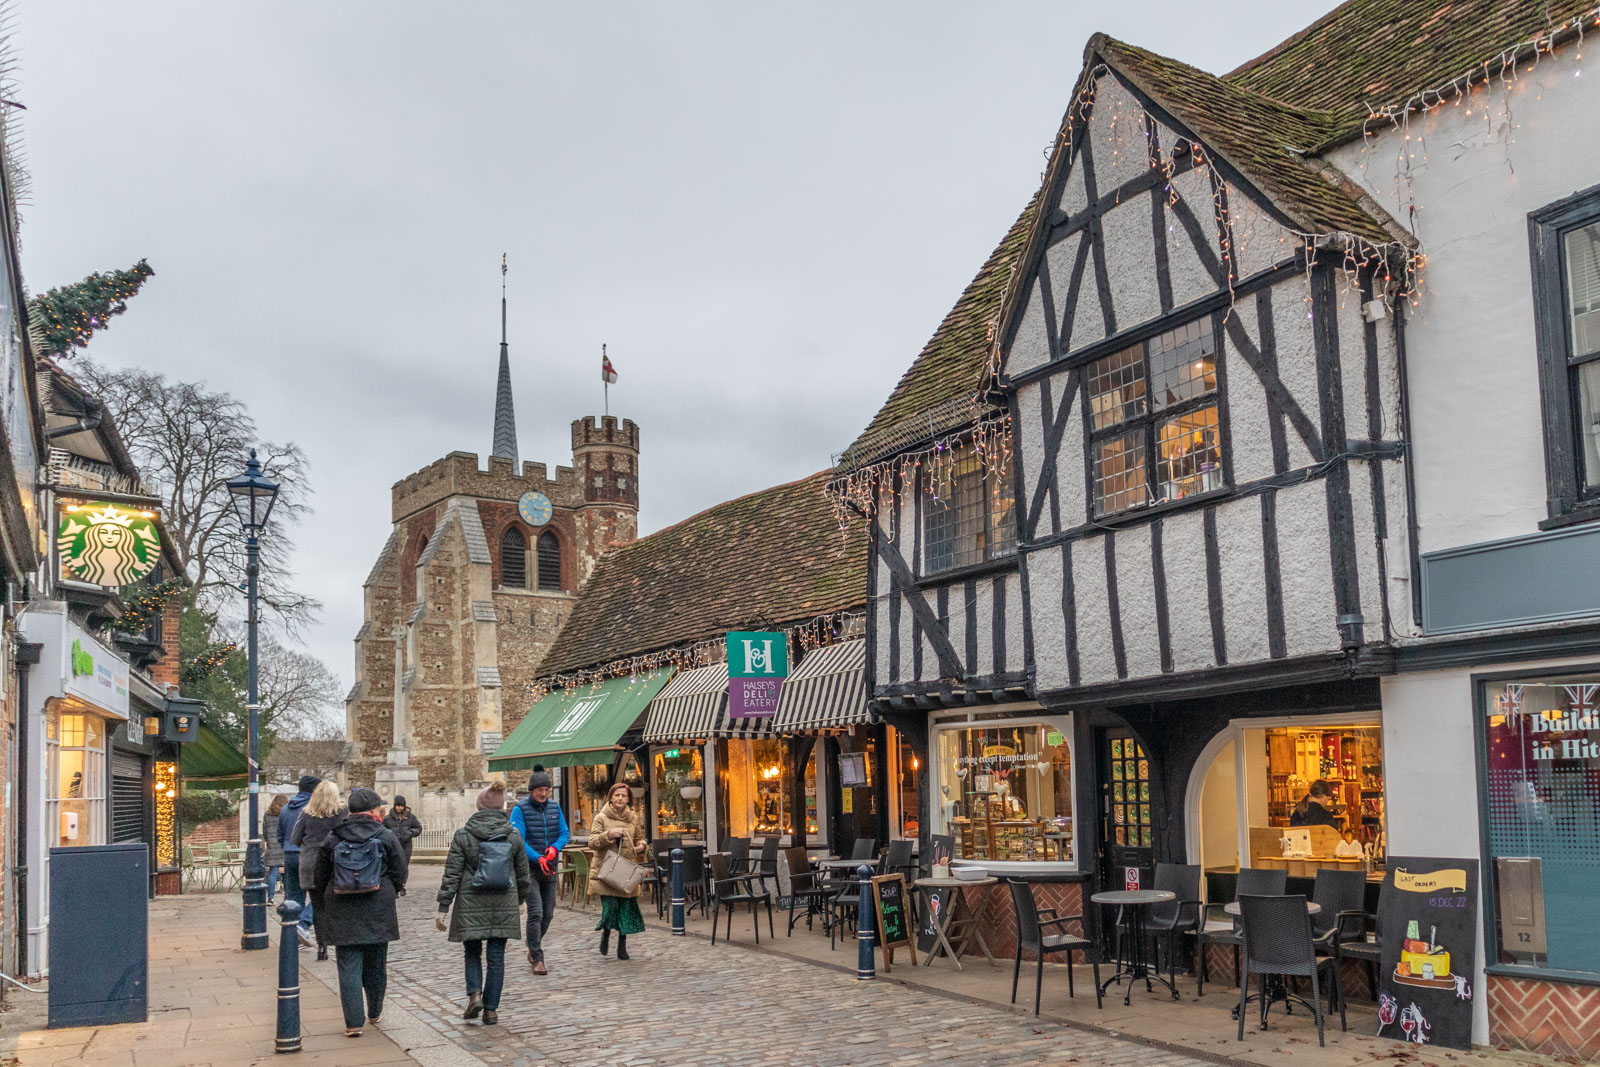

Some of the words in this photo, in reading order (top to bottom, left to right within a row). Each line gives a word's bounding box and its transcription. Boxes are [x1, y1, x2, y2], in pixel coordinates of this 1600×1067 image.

[743, 681, 776, 690] HALSEY'S
[744, 690, 767, 698] DELI
[744, 699, 776, 707] EATERY
[1532, 740, 1555, 760] in
[1561, 738, 1600, 758] Hit
[979, 754, 998, 765] except
[1429, 898, 1437, 906] 15
[1438, 897, 1454, 907] DEC
[1517, 932, 1531, 943] 12
